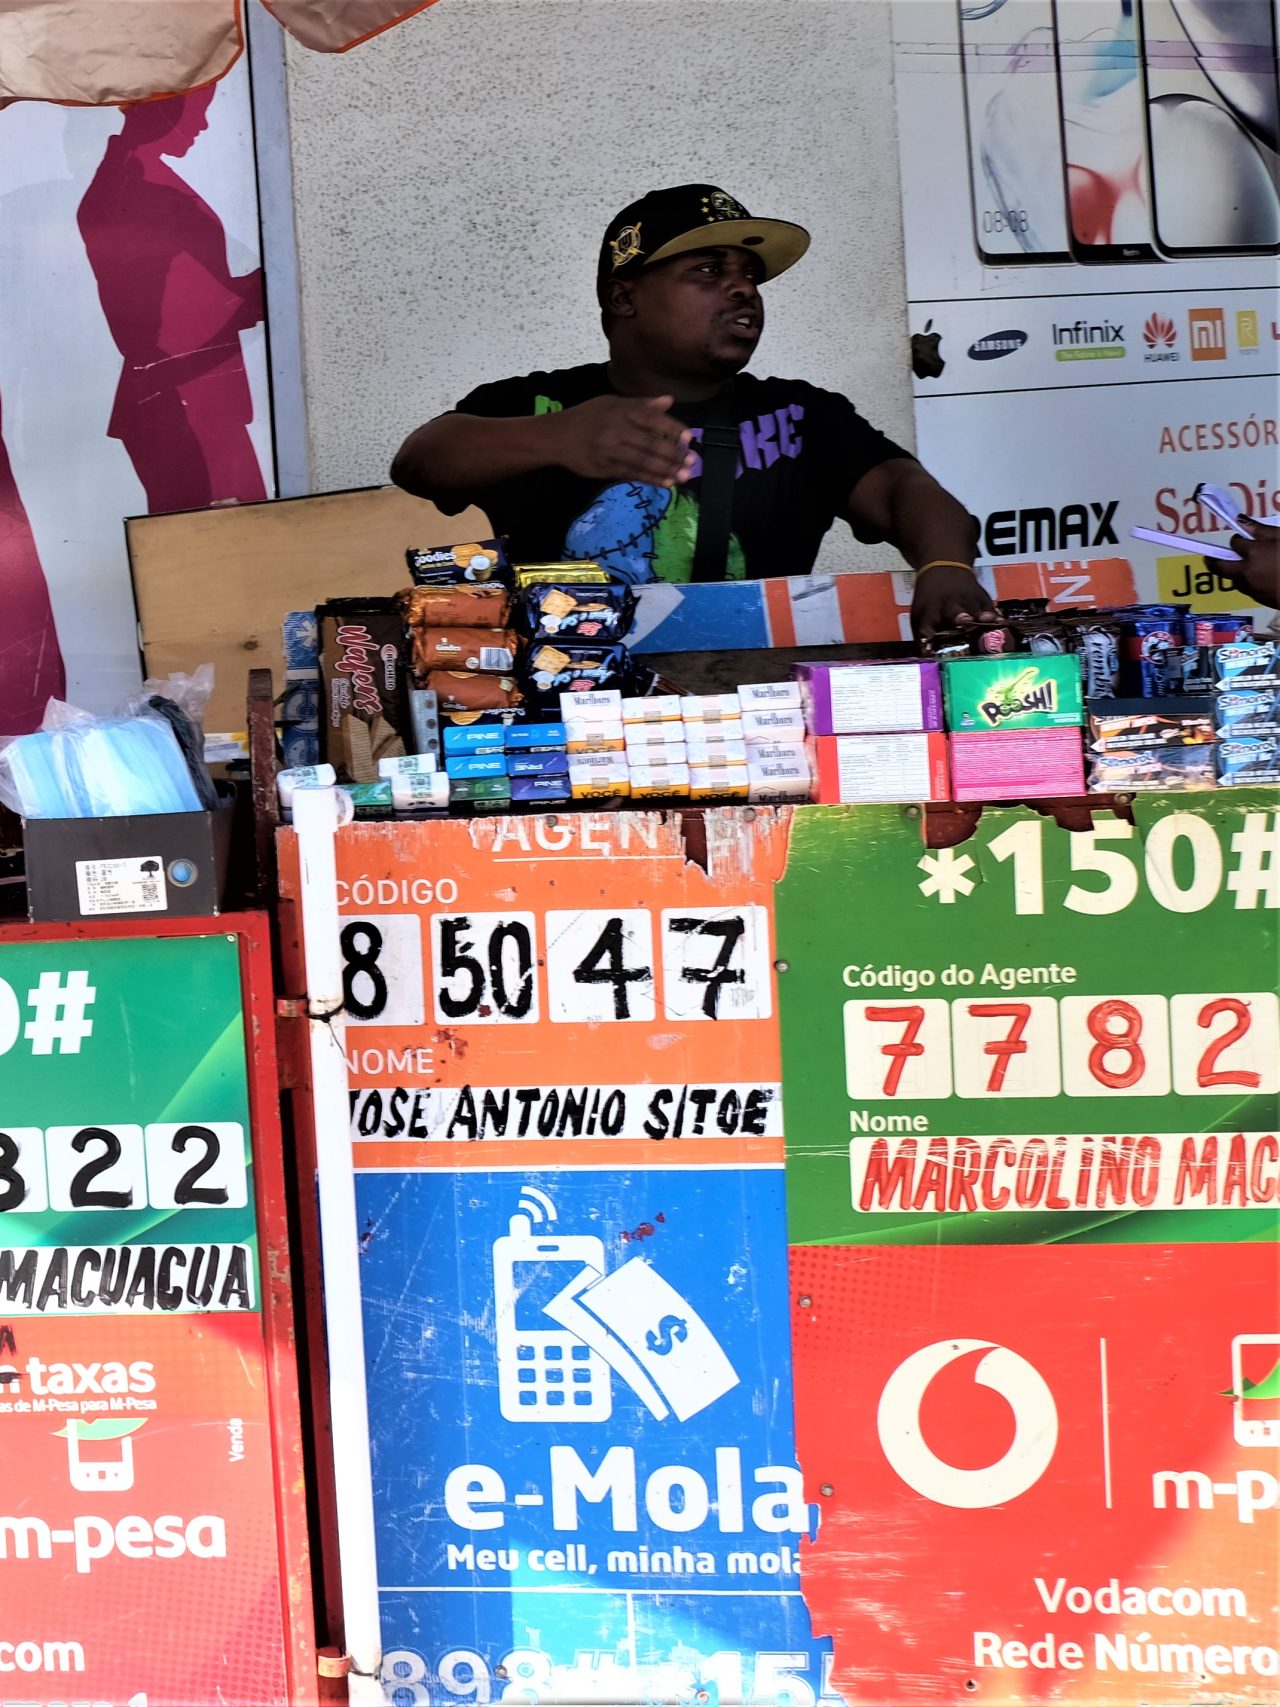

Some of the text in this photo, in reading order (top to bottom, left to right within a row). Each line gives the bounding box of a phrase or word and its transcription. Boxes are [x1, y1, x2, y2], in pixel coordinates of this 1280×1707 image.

[1052, 319, 1125, 345] Infinix
[1144, 352, 1179, 363] HUAWEI
[334, 625, 384, 714] Wafers
[842, 963, 1078, 992] Código do Agente
[446, 1084, 626, 1141] ANTONIO
[849, 1110, 930, 1133] Nome
[859, 1136, 1162, 1213] MARCOLINO
[26, 1356, 157, 1395] taxas
[15, 1399, 32, 1413] de
[33, 1399, 80, 1413] M-Pesa
[81, 1399, 108, 1414] para
[109, 1397, 157, 1411] M-Pesa
[444, 1445, 810, 1533] e-Mola
[447, 1544, 518, 1571] Meu
[528, 1545, 598, 1576] cell,
[607, 1546, 715, 1574] minha
[1034, 1577, 1248, 1617] Vodacom
[973, 1631, 1280, 1677] Rede Número
